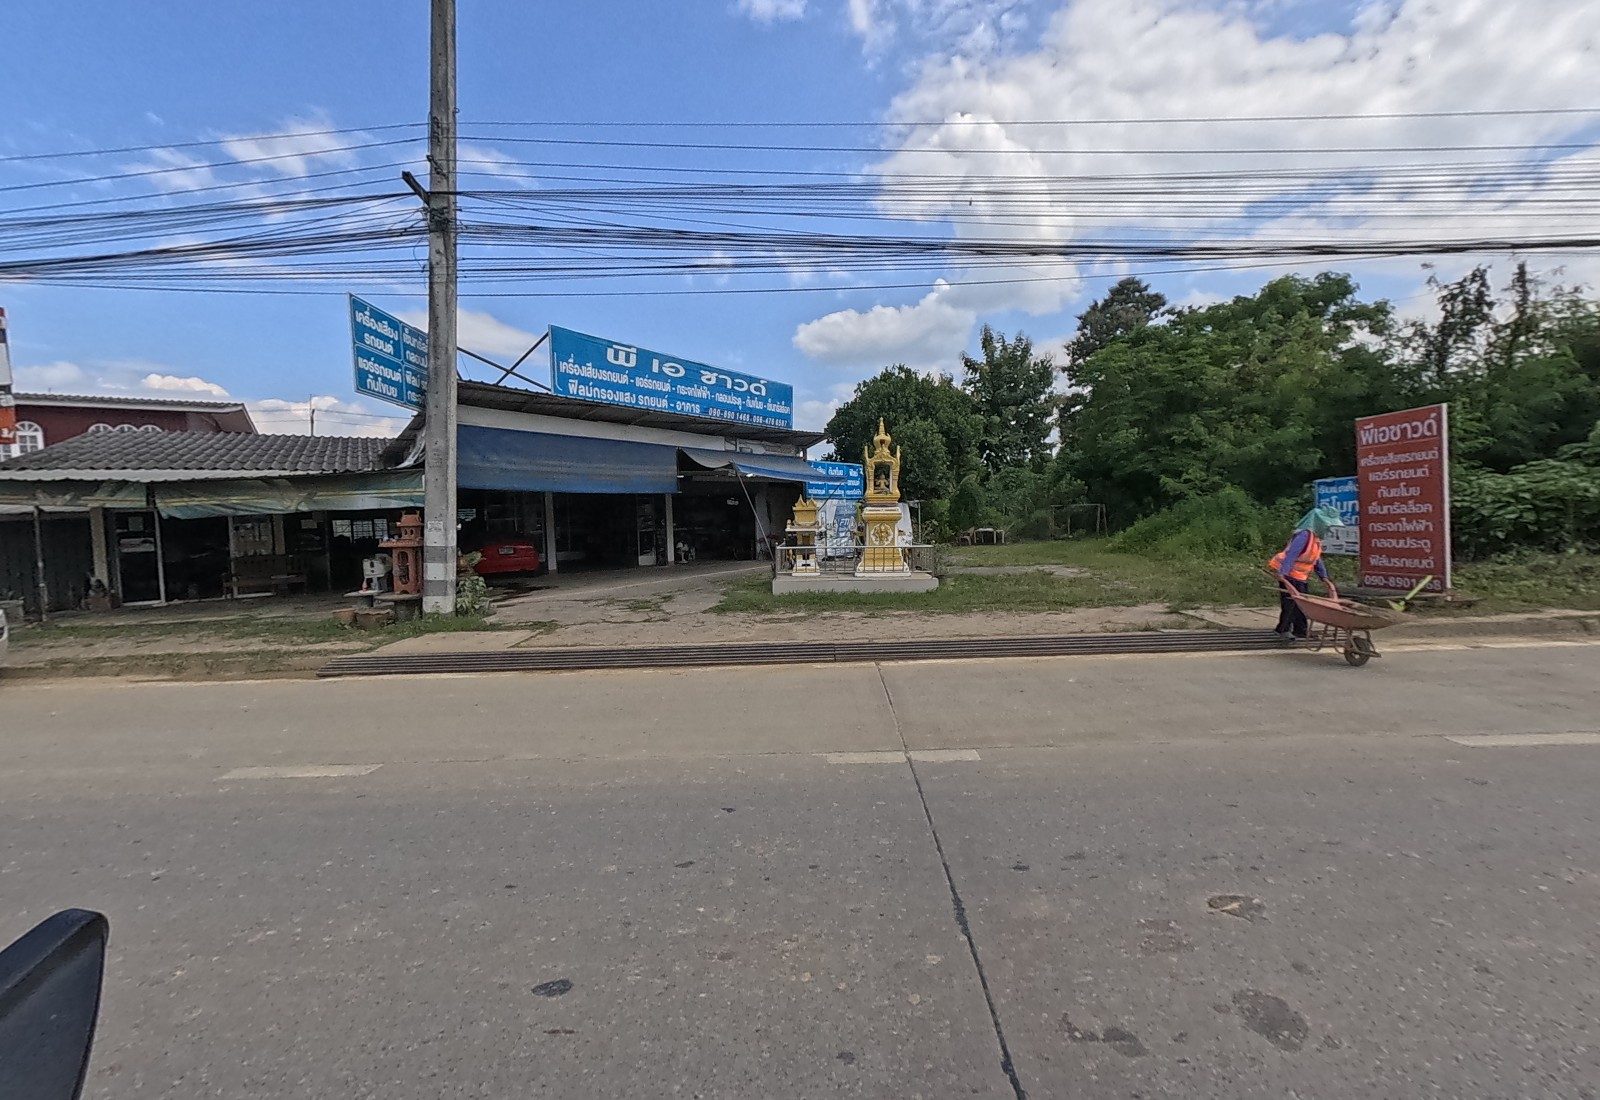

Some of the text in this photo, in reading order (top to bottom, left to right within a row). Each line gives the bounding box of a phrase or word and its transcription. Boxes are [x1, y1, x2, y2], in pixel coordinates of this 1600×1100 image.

[355, 306, 398, 340] เครื่องเสียง
[364, 333, 394, 355] รถยนต์
[358, 357, 402, 383] แอร์รถยนต์
[559, 353, 629, 385] เครื่องเสียงรถยนต์
[635, 374, 671, 393] แอร์รถยนต์
[606, 344, 768, 396] พี เอ ซาวด์
[366, 373, 397, 397] กันขโมย
[638, 394, 669, 409] รถยนต์
[676, 401, 700, 414] อาคาร
[1368, 465, 1429, 482] แอร์รถยนต์
[1369, 517, 1433, 532] กระจกไฟฟ้า
[1371, 536, 1431, 554] กลอนประตู
